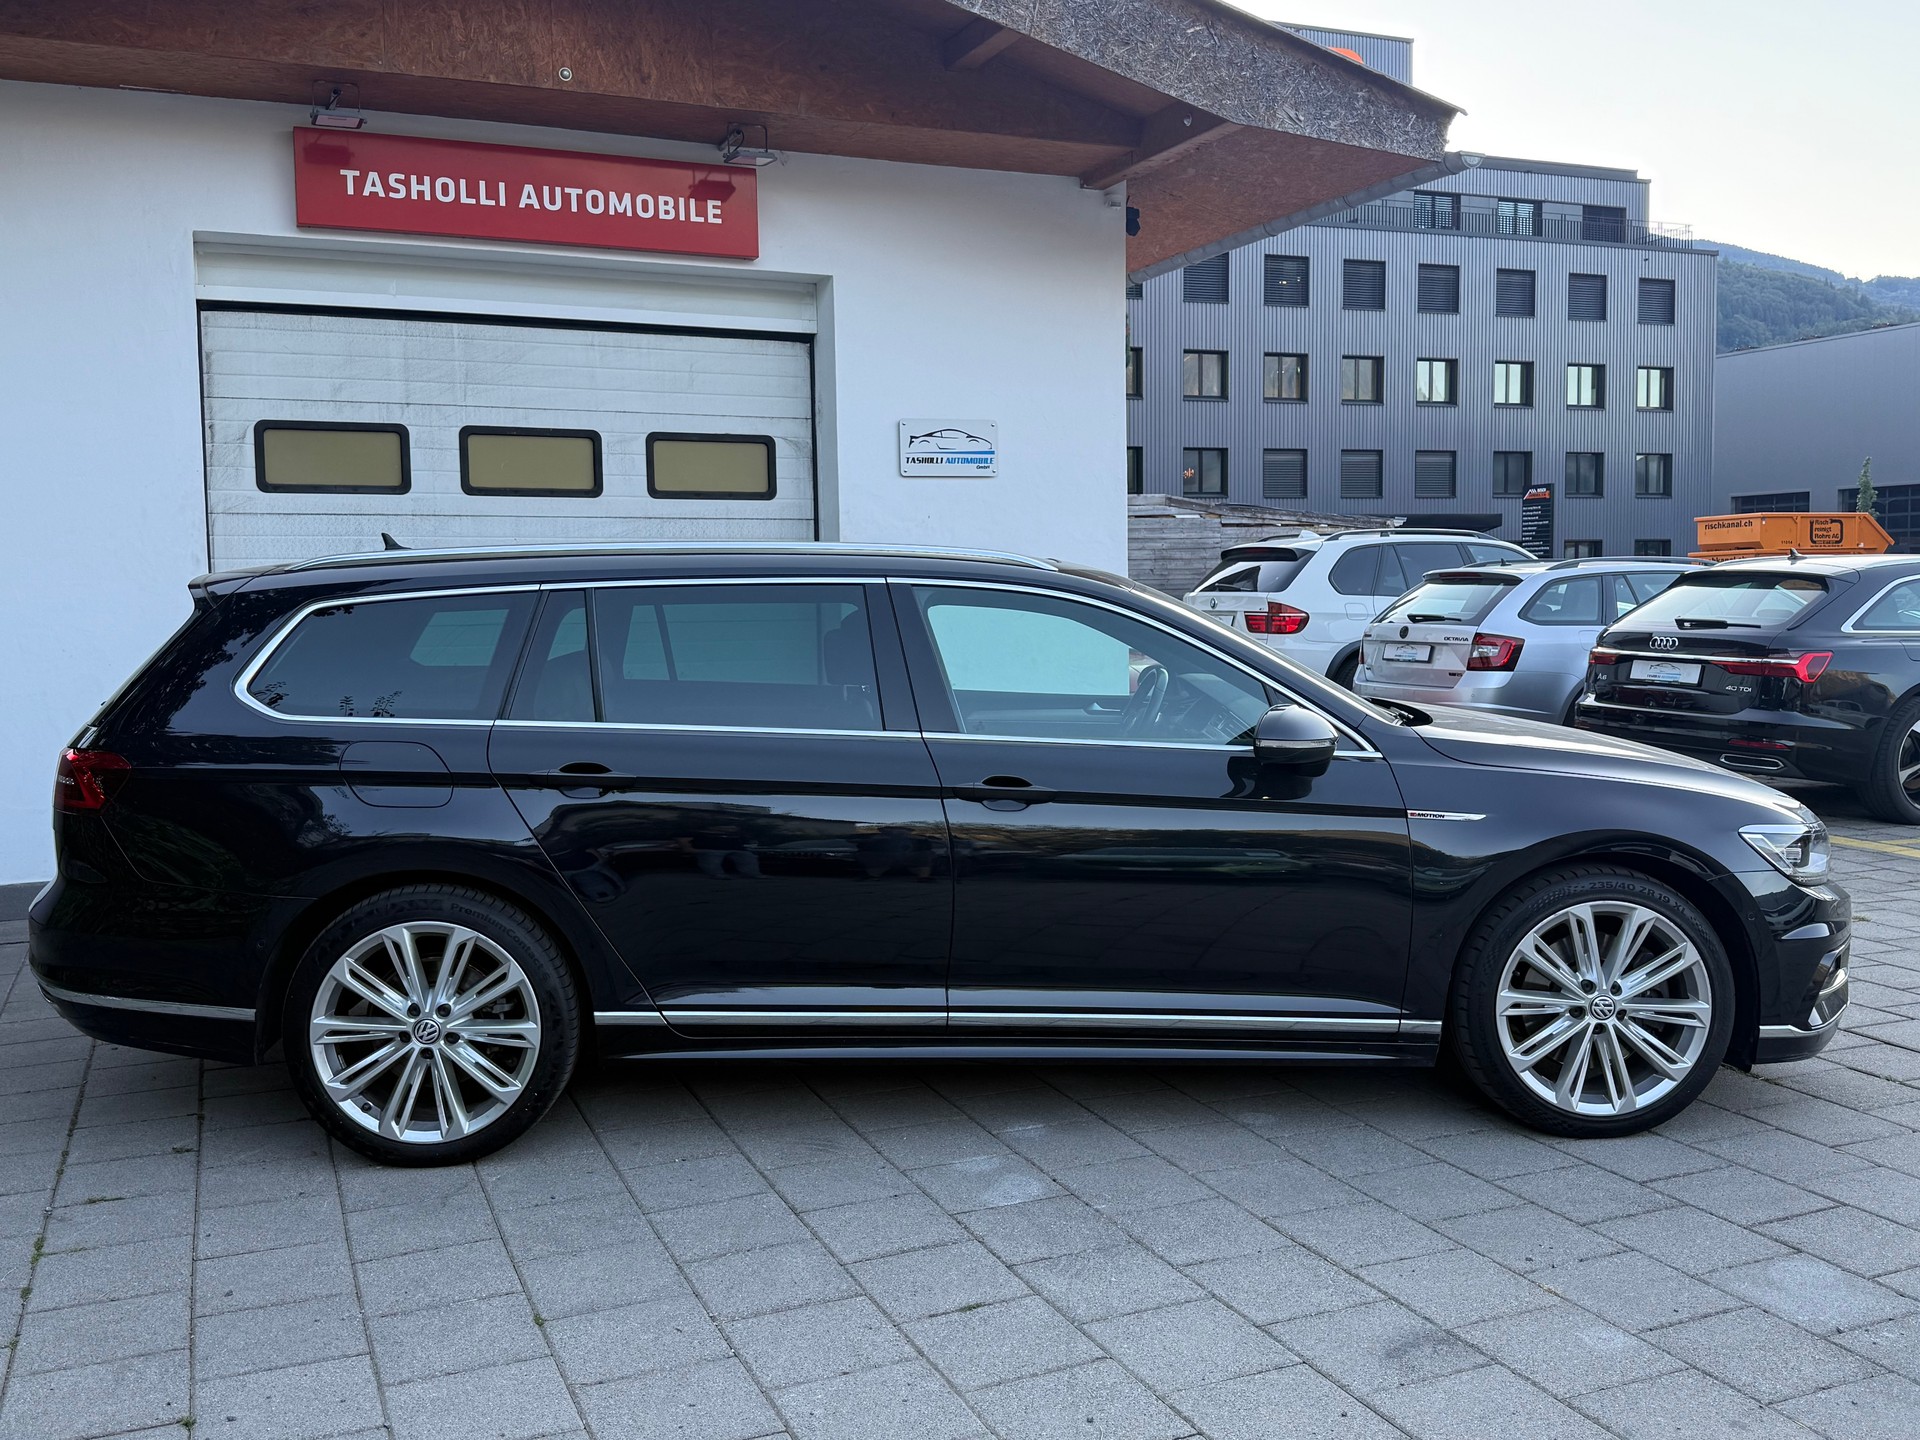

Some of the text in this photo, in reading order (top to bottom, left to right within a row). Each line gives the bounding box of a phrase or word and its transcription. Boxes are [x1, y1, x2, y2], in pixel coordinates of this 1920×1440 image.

[340, 169, 723, 225] TASHOLLI AUTOMOBILE
[905, 457, 994, 465] TASHOLLI AUTOMOBILE
[1704, 520, 1753, 530] rischkanal.ch
[1588, 881, 1687, 915] 235/40 ZR 19 XL
[450, 903, 545, 970] PremiumContact
